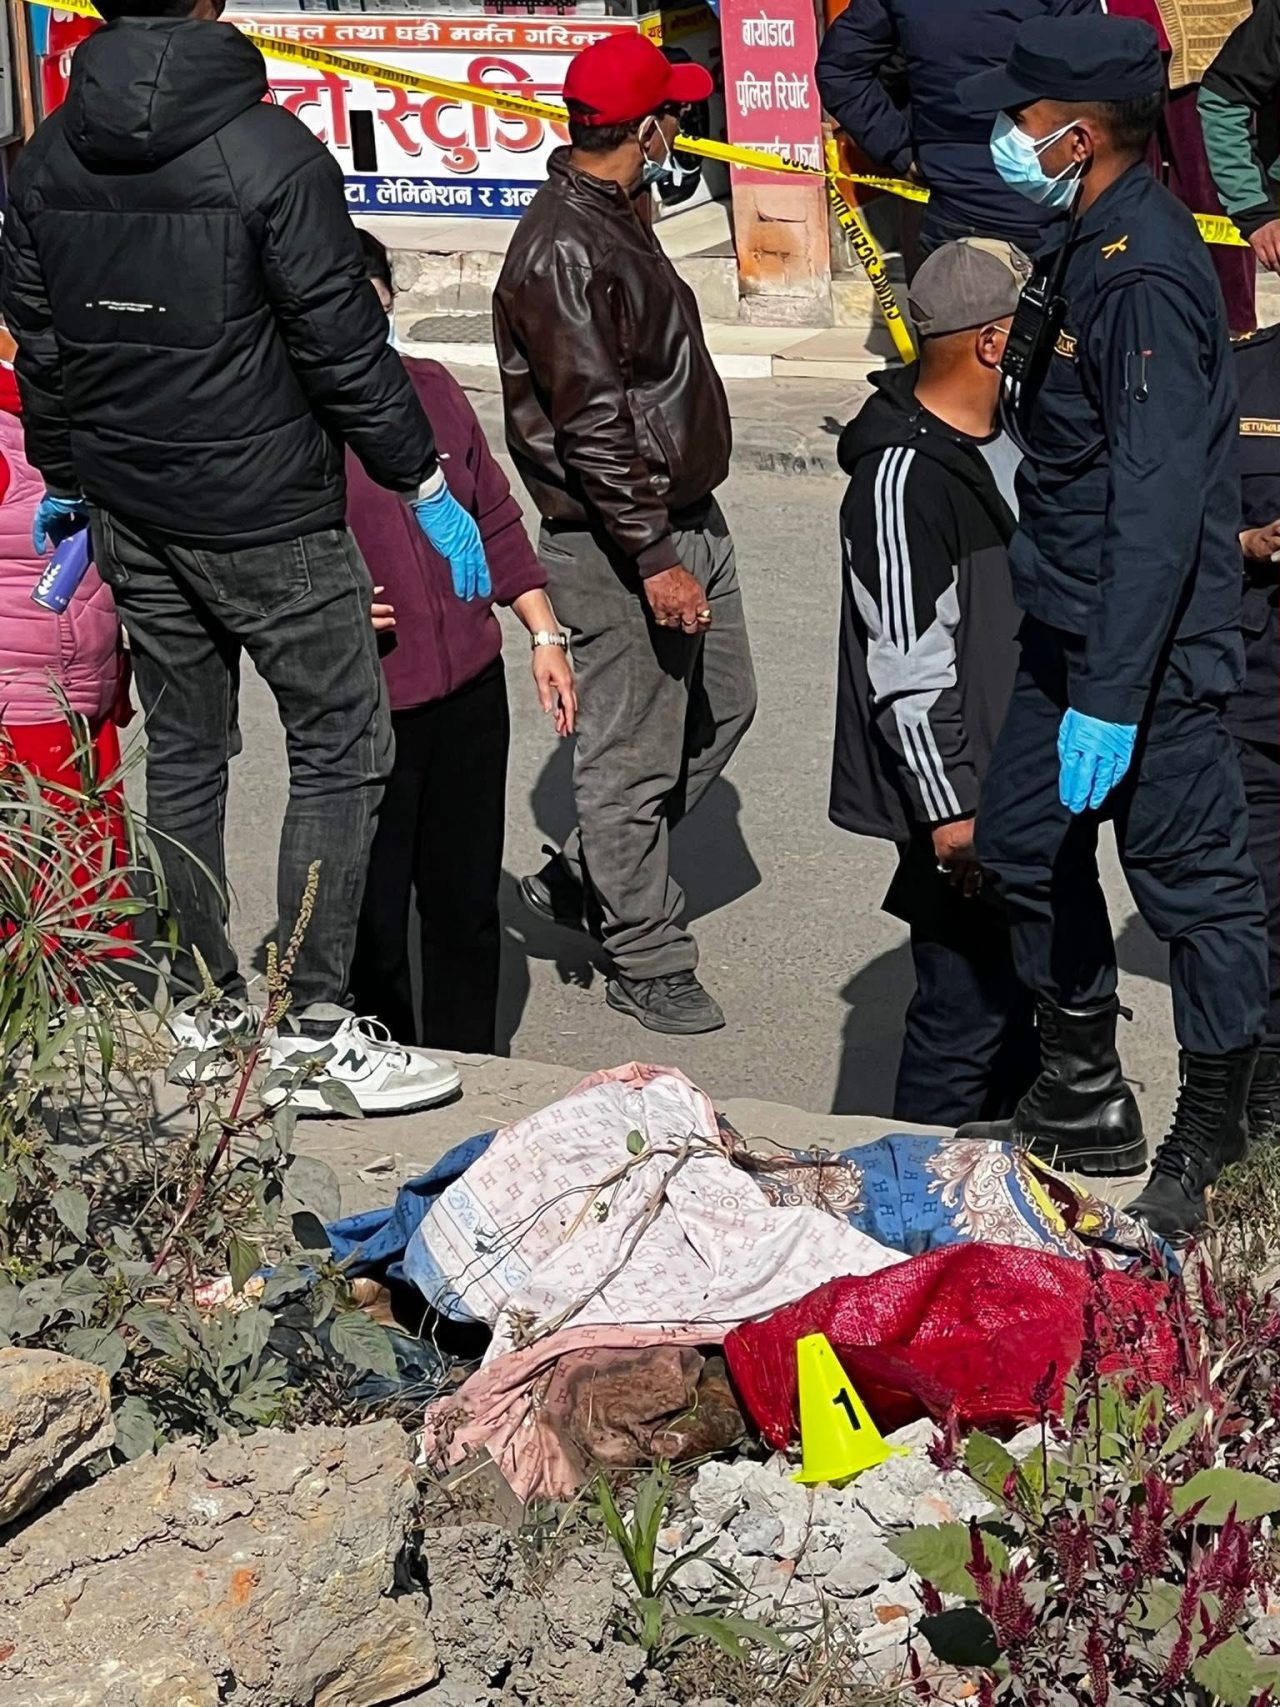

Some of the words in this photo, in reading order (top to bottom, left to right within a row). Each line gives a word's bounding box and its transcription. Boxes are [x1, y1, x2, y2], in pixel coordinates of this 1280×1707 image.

[334, 25, 387, 41] तथा
[395, 22, 441, 41] घडी
[449, 23, 516, 43] मर्मत
[742, 10, 795, 47] बायोडाटा
[373, 56, 572, 174] स्टुडि
[735, 70, 772, 117] पुलिस
[774, 71, 810, 111] रिपोर्ट
[377, 180, 472, 206] लेमिनेशन
[479, 187, 493, 207] र
[870, 267, 901, 321] CRIME
[832, 1387, 862, 1431] 1
